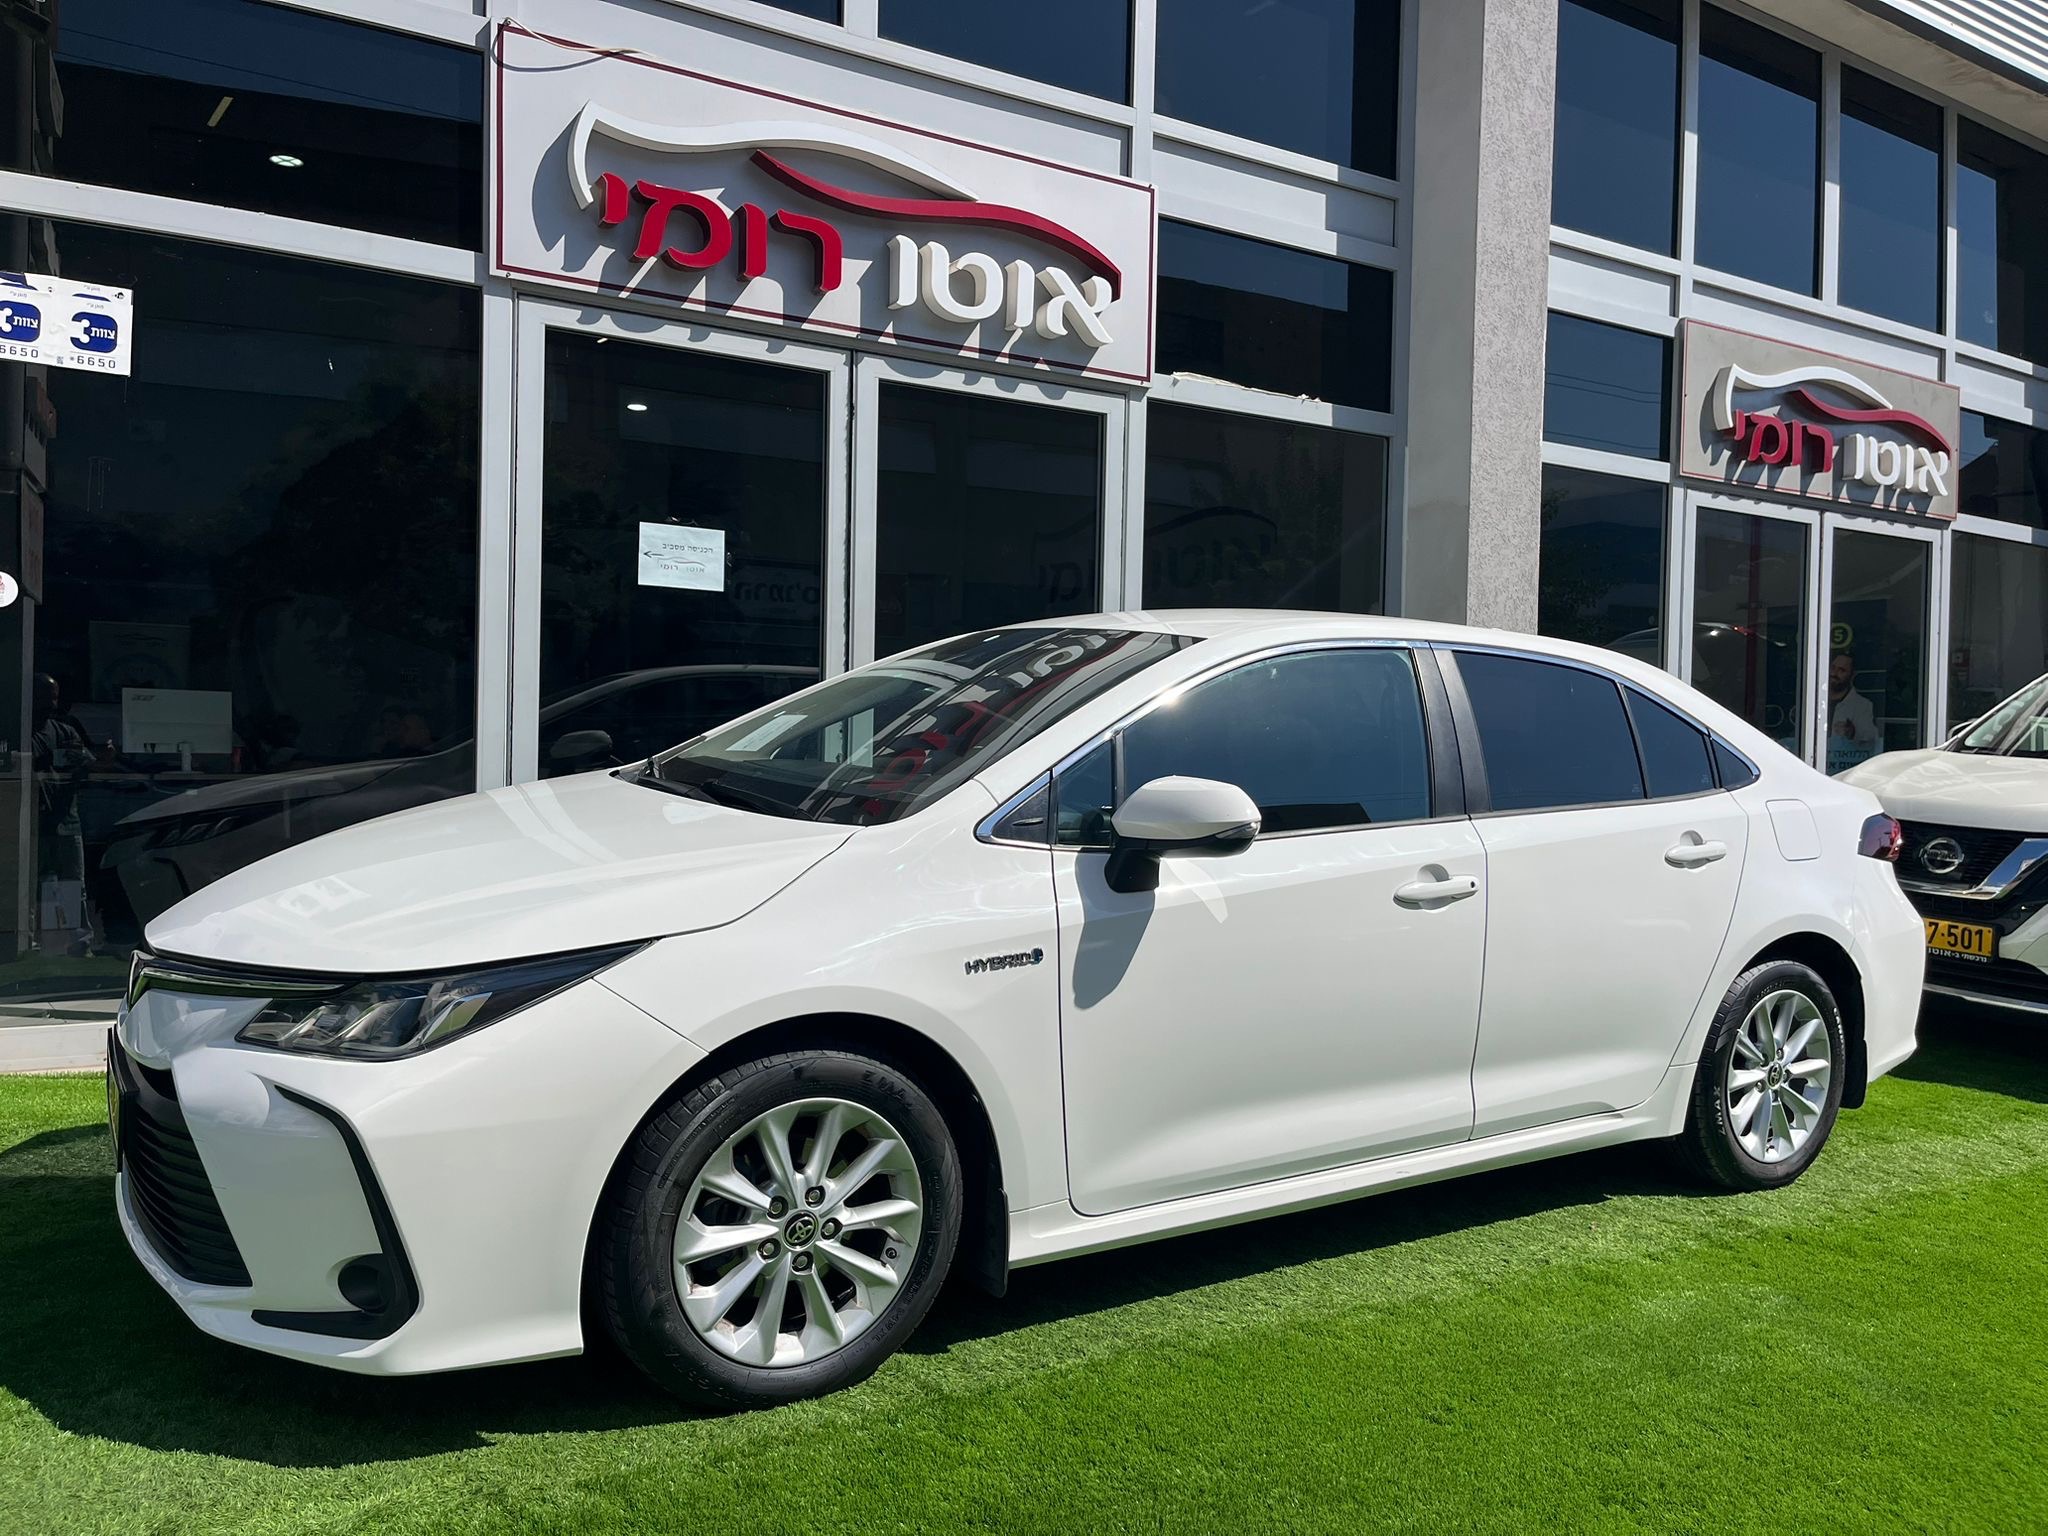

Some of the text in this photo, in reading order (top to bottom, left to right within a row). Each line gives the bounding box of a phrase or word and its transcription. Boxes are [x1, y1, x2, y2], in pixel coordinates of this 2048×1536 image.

[598, 171, 1114, 348] אוטו רומי
[12, 315, 39, 329] צוות
[70, 319, 116, 344] צוות 3
[1734, 409, 1949, 496] אוטו רומי
[662, 543, 714, 554] הכניסה מסביב
[964, 952, 1031, 975] HYBRID
